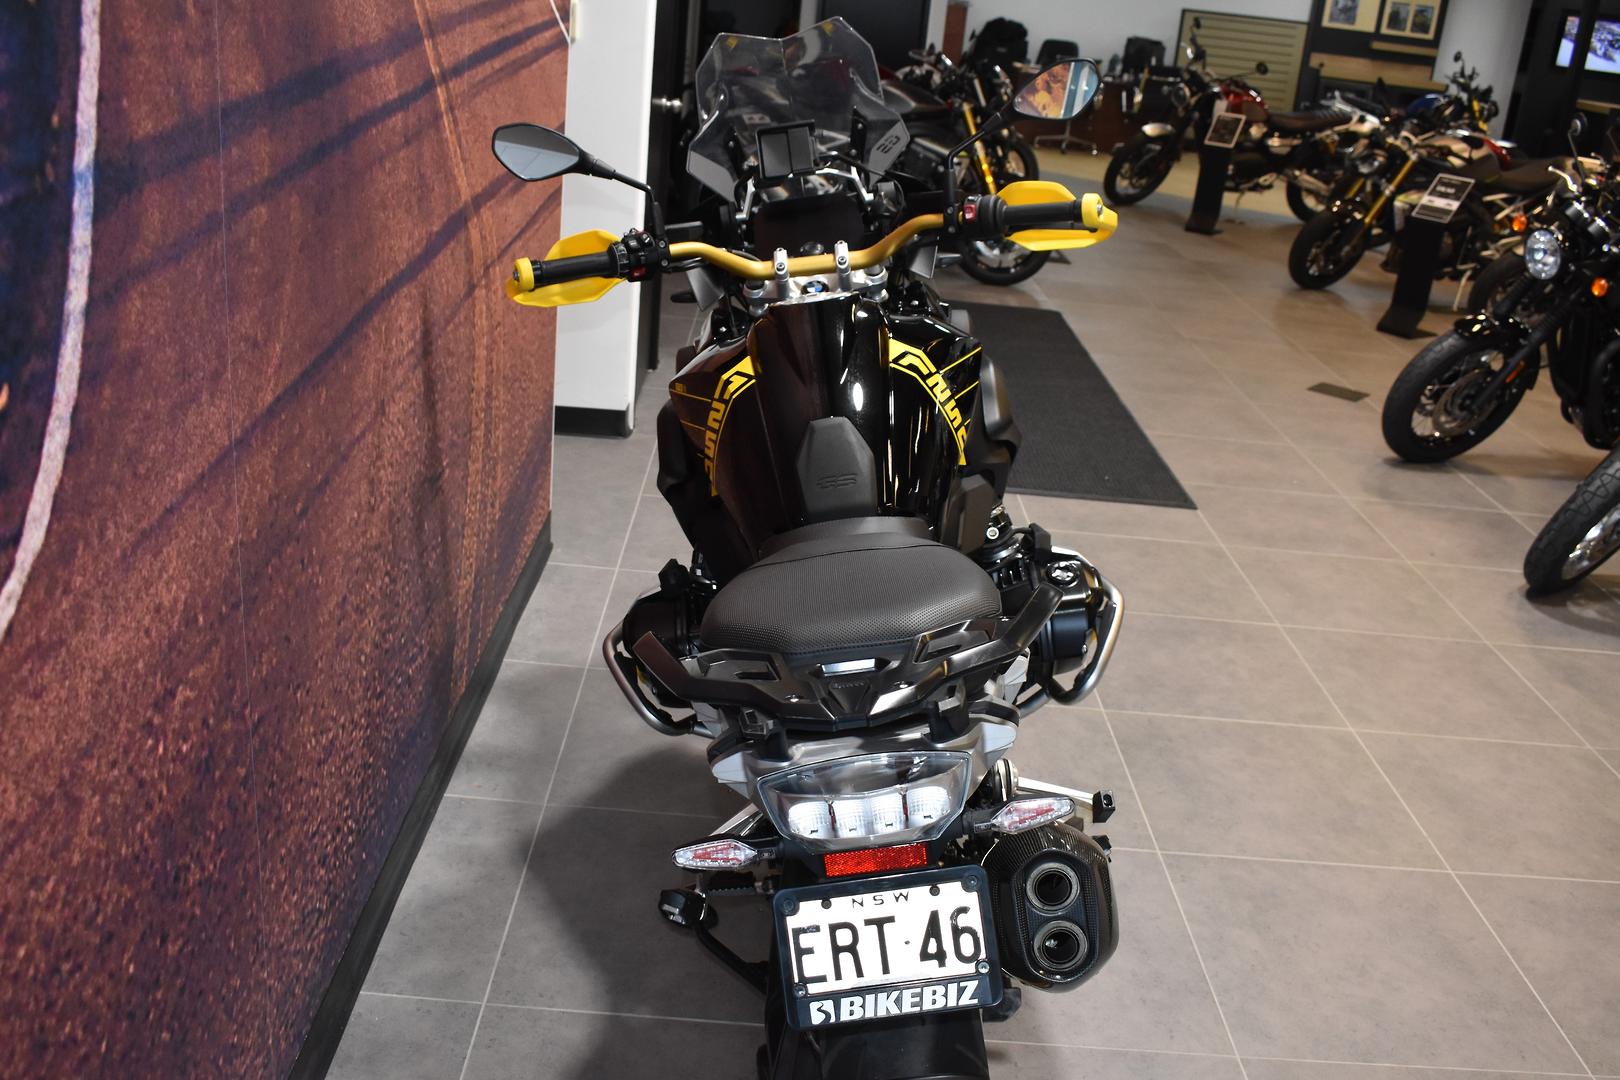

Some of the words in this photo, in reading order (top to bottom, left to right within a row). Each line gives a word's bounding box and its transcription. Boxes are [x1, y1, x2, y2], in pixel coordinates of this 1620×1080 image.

[851, 891, 909, 908] NSW
[791, 915, 896, 984] ERT
[919, 906, 982, 968] 46
[840, 980, 979, 1022] BIKEBIZ
